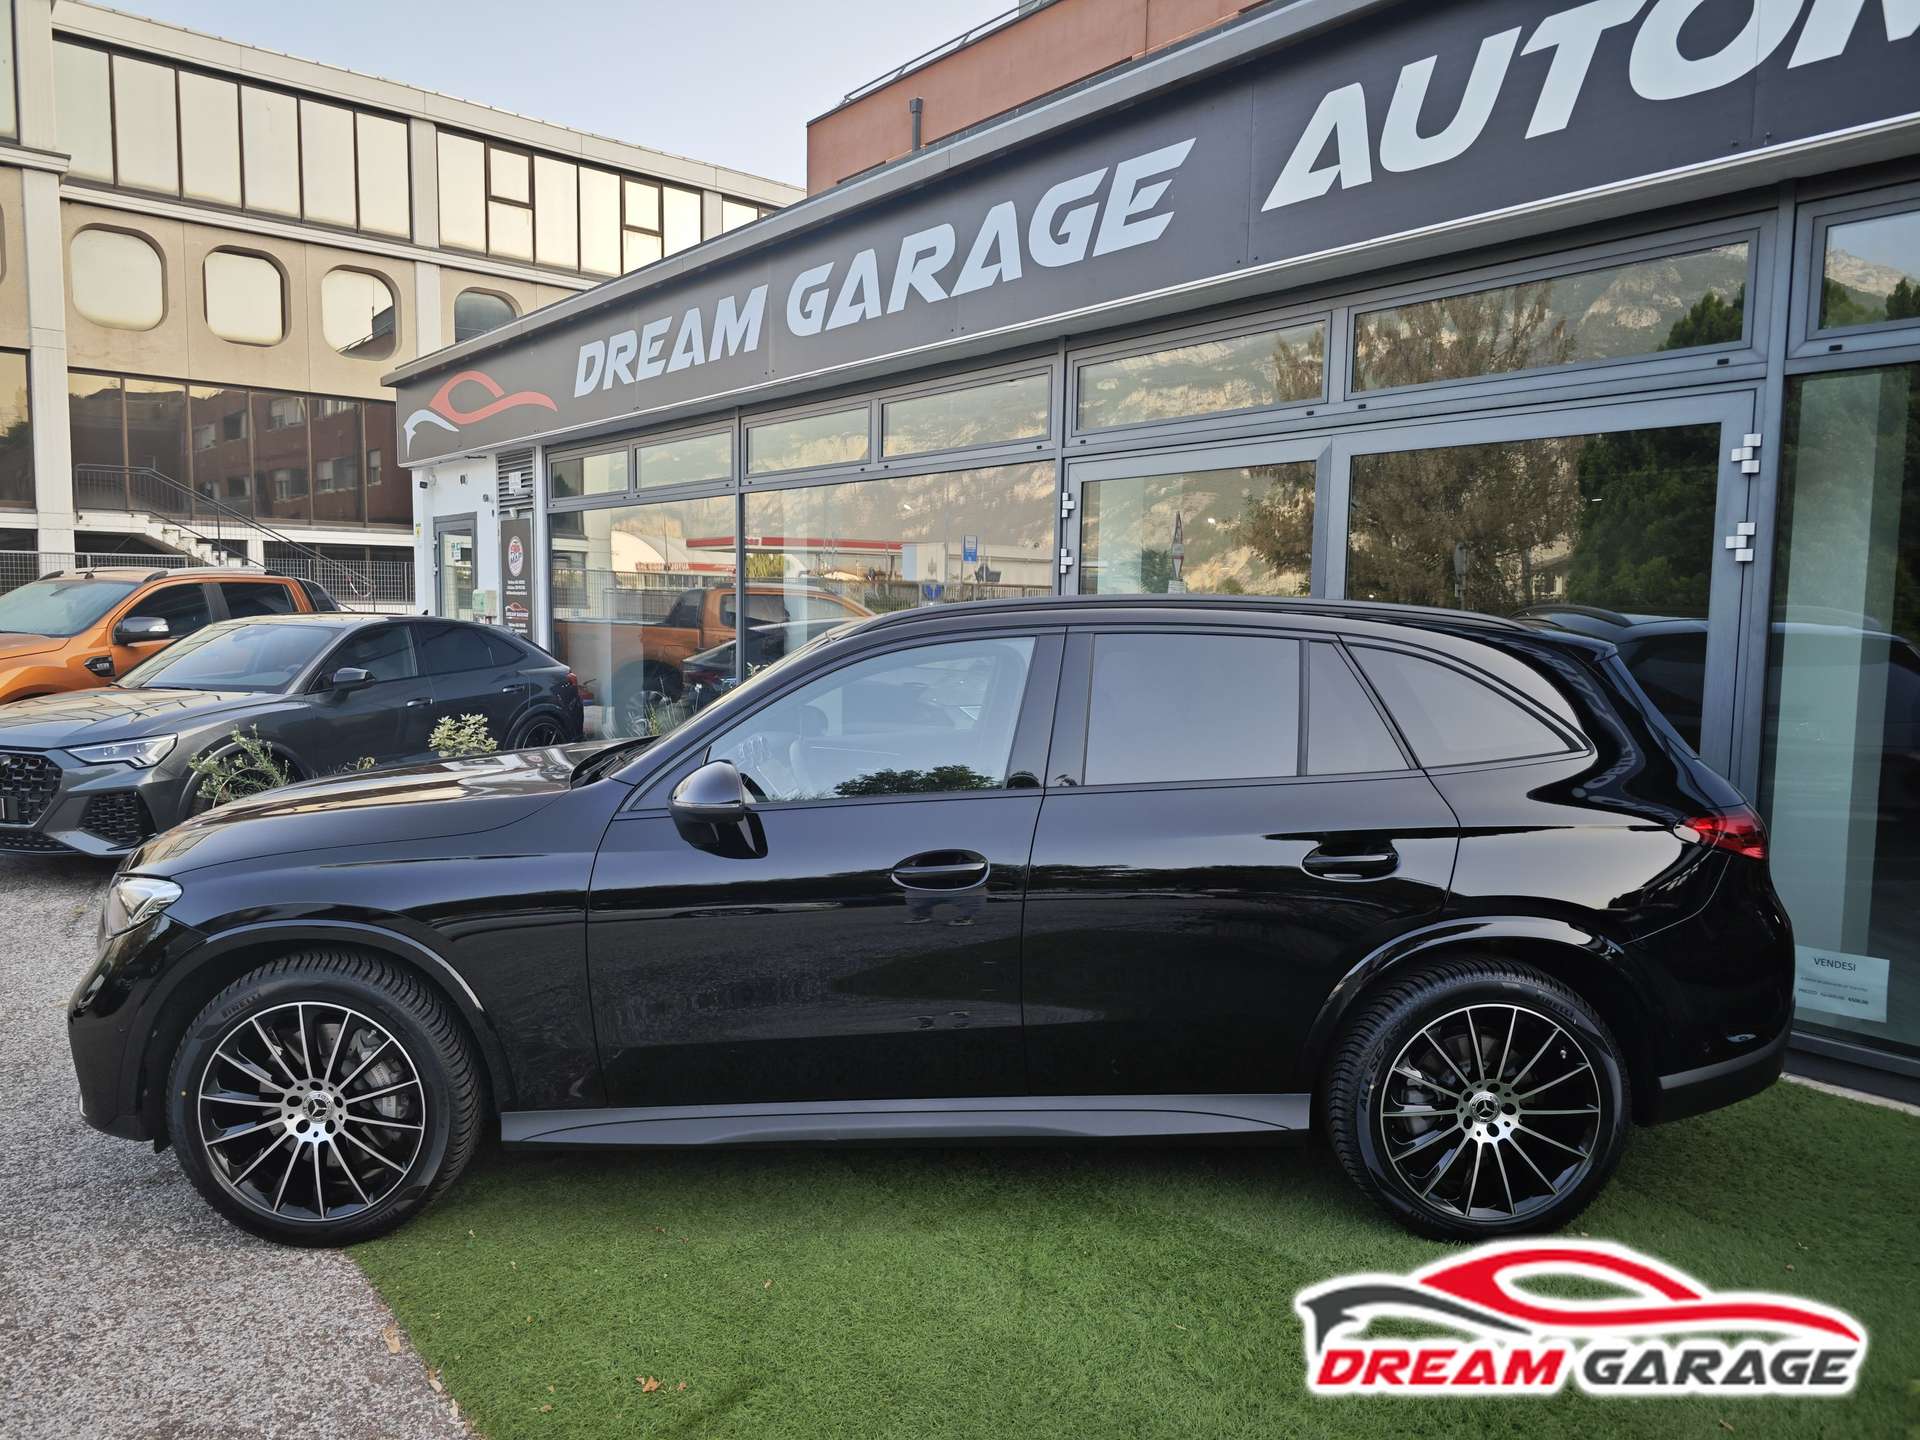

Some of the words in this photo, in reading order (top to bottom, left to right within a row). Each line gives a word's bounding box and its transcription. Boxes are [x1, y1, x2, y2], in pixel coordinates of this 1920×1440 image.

[574, 284, 768, 400] DREAM
[786, 137, 1197, 336] GARAGE
[1813, 958, 1857, 972] VENDESI
